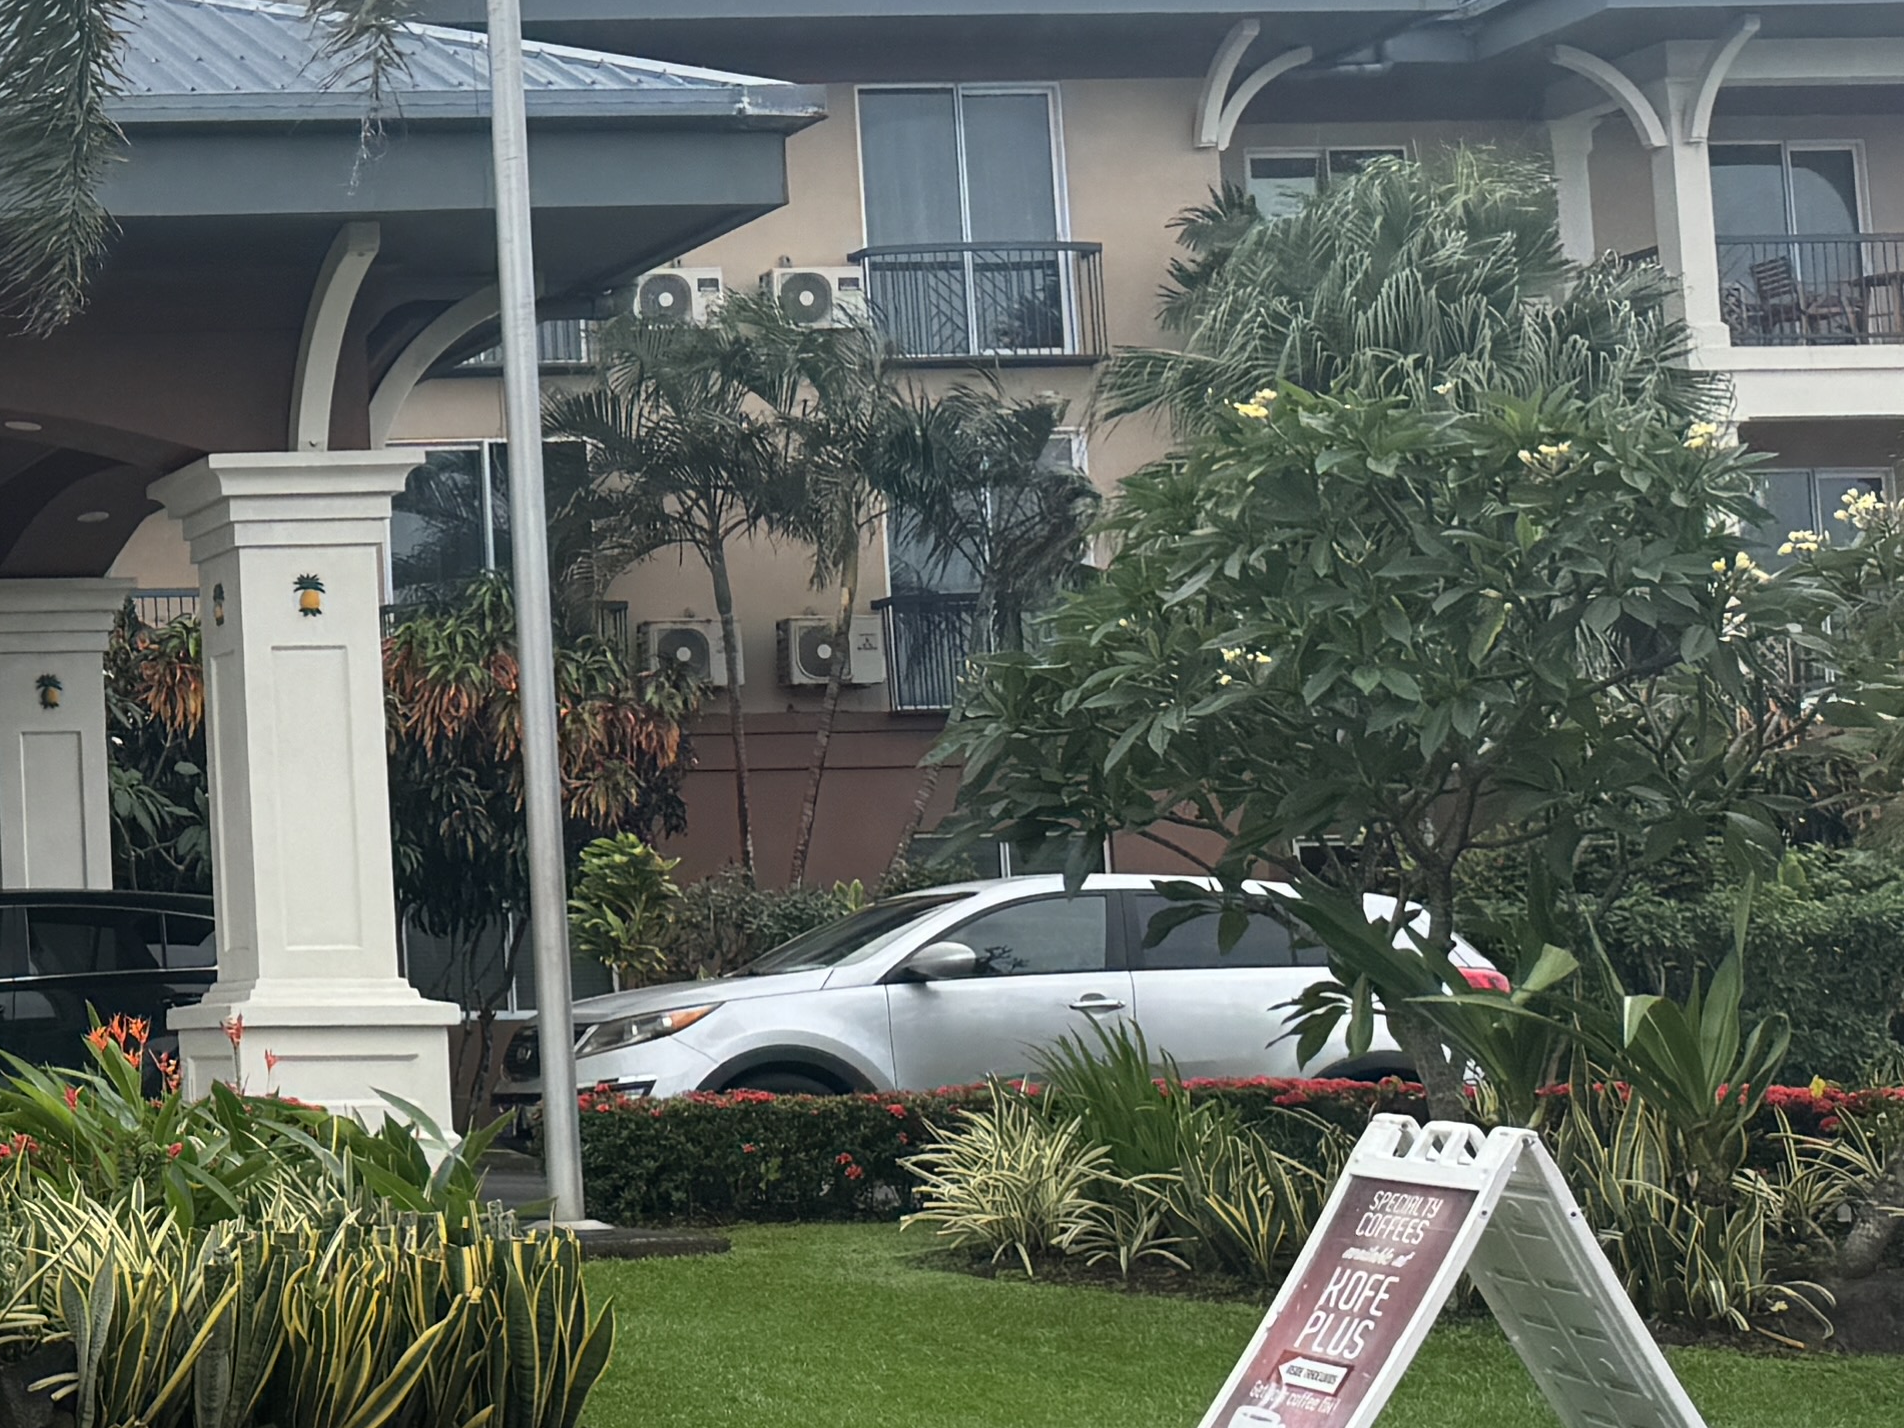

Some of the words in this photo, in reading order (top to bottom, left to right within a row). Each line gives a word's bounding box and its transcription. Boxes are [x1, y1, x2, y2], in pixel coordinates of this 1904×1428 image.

[1369, 1190, 1444, 1219] SPECIALTY
[1355, 1212, 1430, 1245] COFFEES
[1314, 1266, 1400, 1317] KOFE
[1293, 1310, 1375, 1360] PLUS
[1286, 1391, 1321, 1412] coffee
